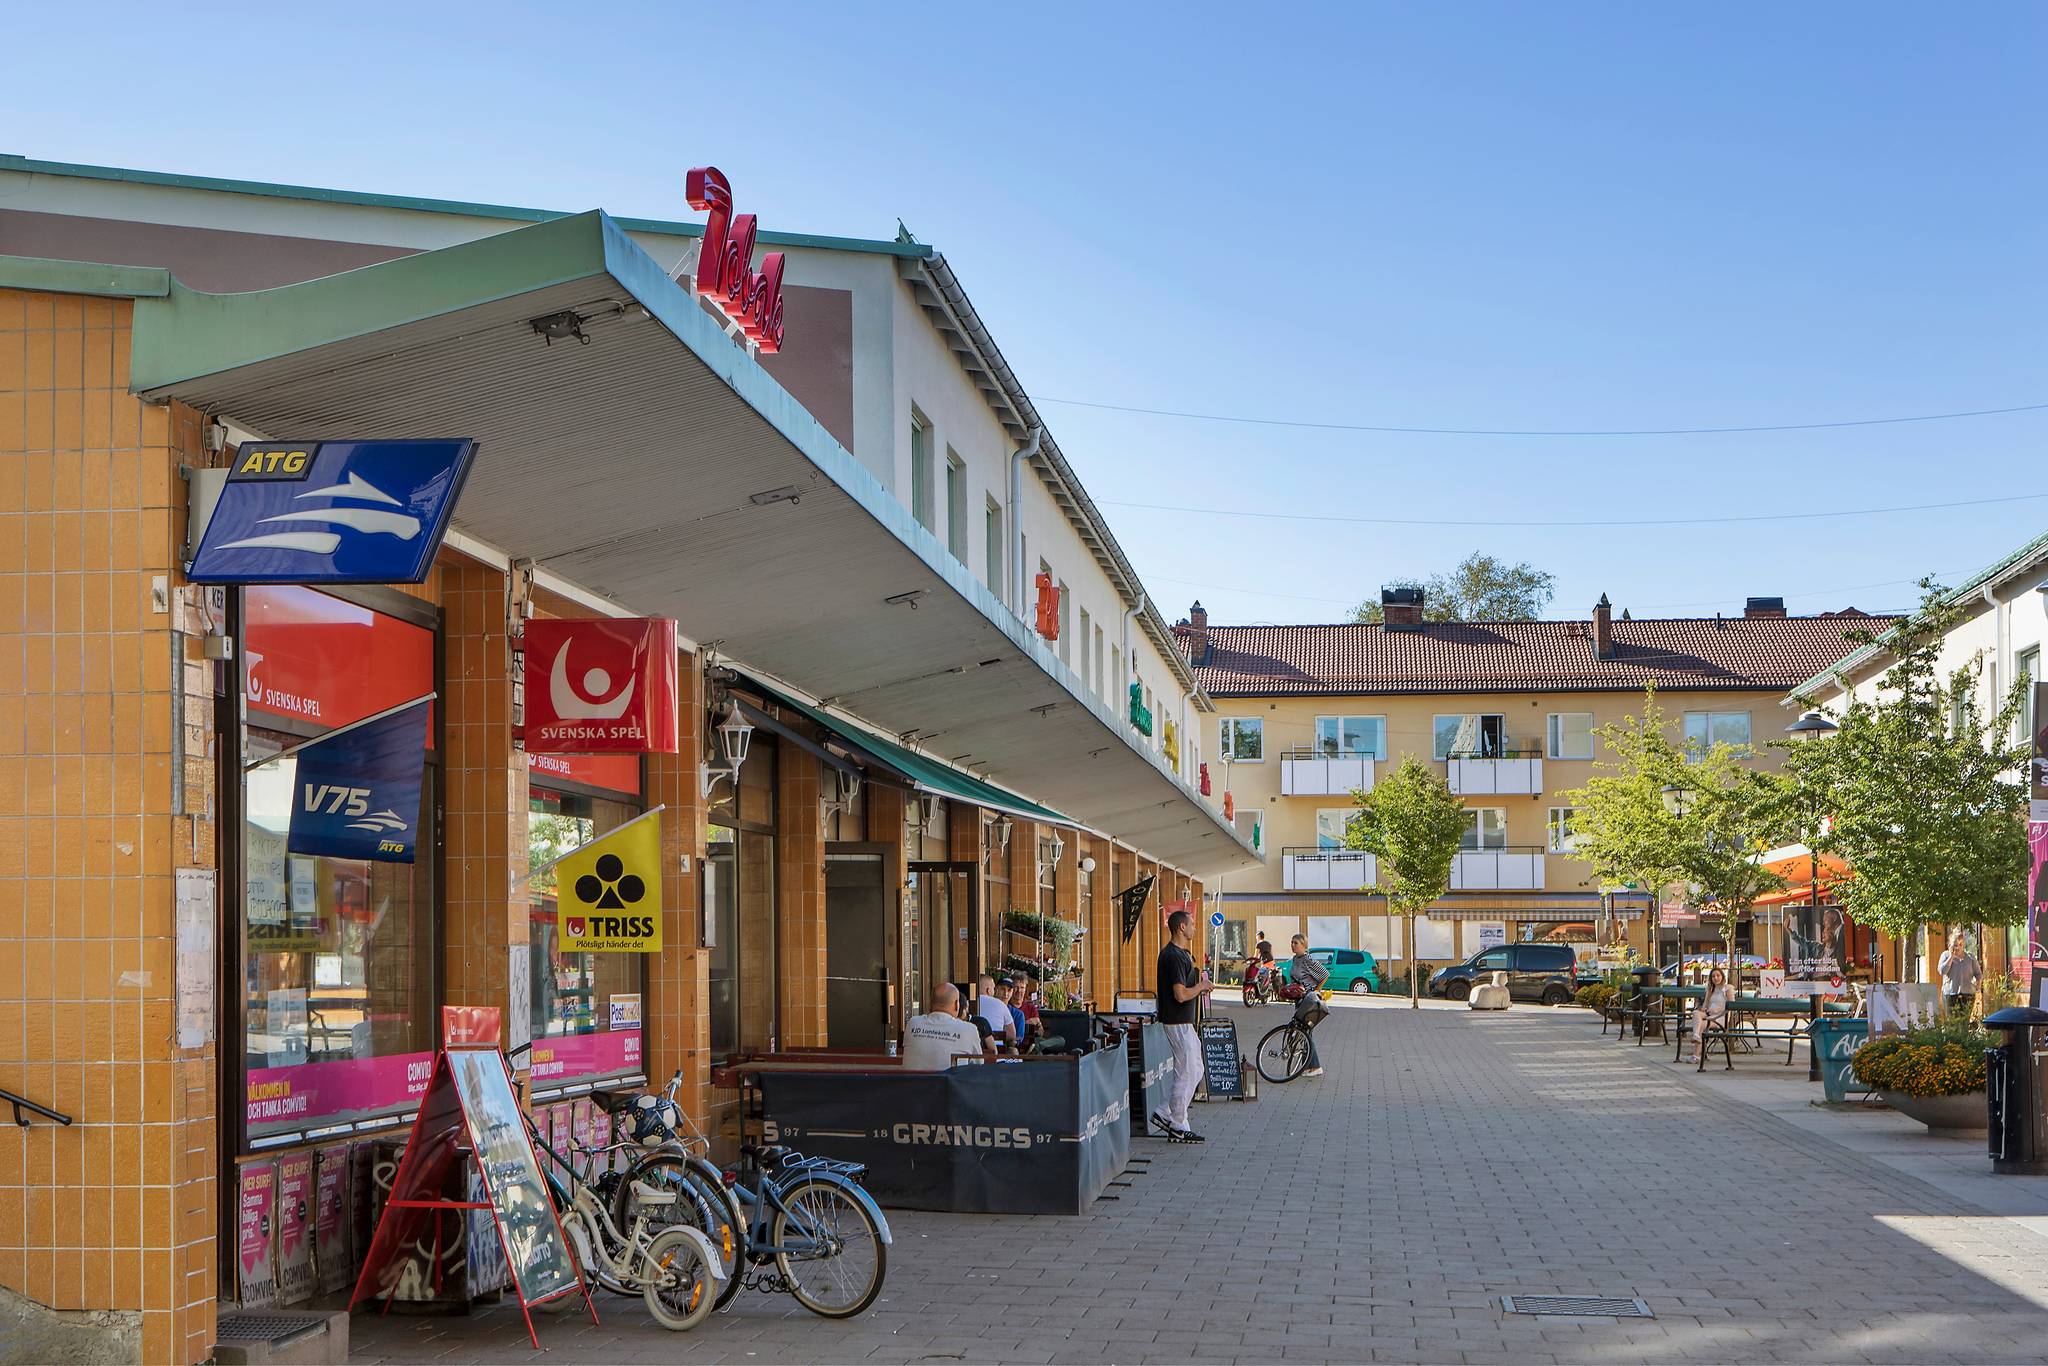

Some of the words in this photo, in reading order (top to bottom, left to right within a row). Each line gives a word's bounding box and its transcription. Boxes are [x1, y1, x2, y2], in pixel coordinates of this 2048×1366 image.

[240, 451, 307, 473] ATG
[266, 688, 301, 712] SVENSKA
[302, 698, 321, 717] SPEL
[541, 727, 605, 739] SVENSKA
[610, 727, 645, 739] SPEL
[538, 756, 560, 771] SVENSKA
[559, 761, 571, 774] SPEL
[305, 783, 371, 816] V75
[379, 842, 404, 853] ATG
[589, 917, 654, 938] TRISS
[576, 939, 605, 949] Plötsligt
[606, 939, 631, 948] händer
[632, 939, 644, 948] det
[248, 1081, 283, 1102] VÄLKOMMEN
[248, 1102, 261, 1119] OCH
[261, 1099, 282, 1118] TANKA
[282, 1095, 307, 1115] COMVIQ!
[784, 1127, 800, 1137] 97
[873, 1129, 888, 1138] 18
[892, 1122, 1032, 1149] GRÄNGES
[1036, 1134, 1052, 1144] 97
[243, 1176, 255, 1192] MER
[242, 1193, 263, 1208] Samma
